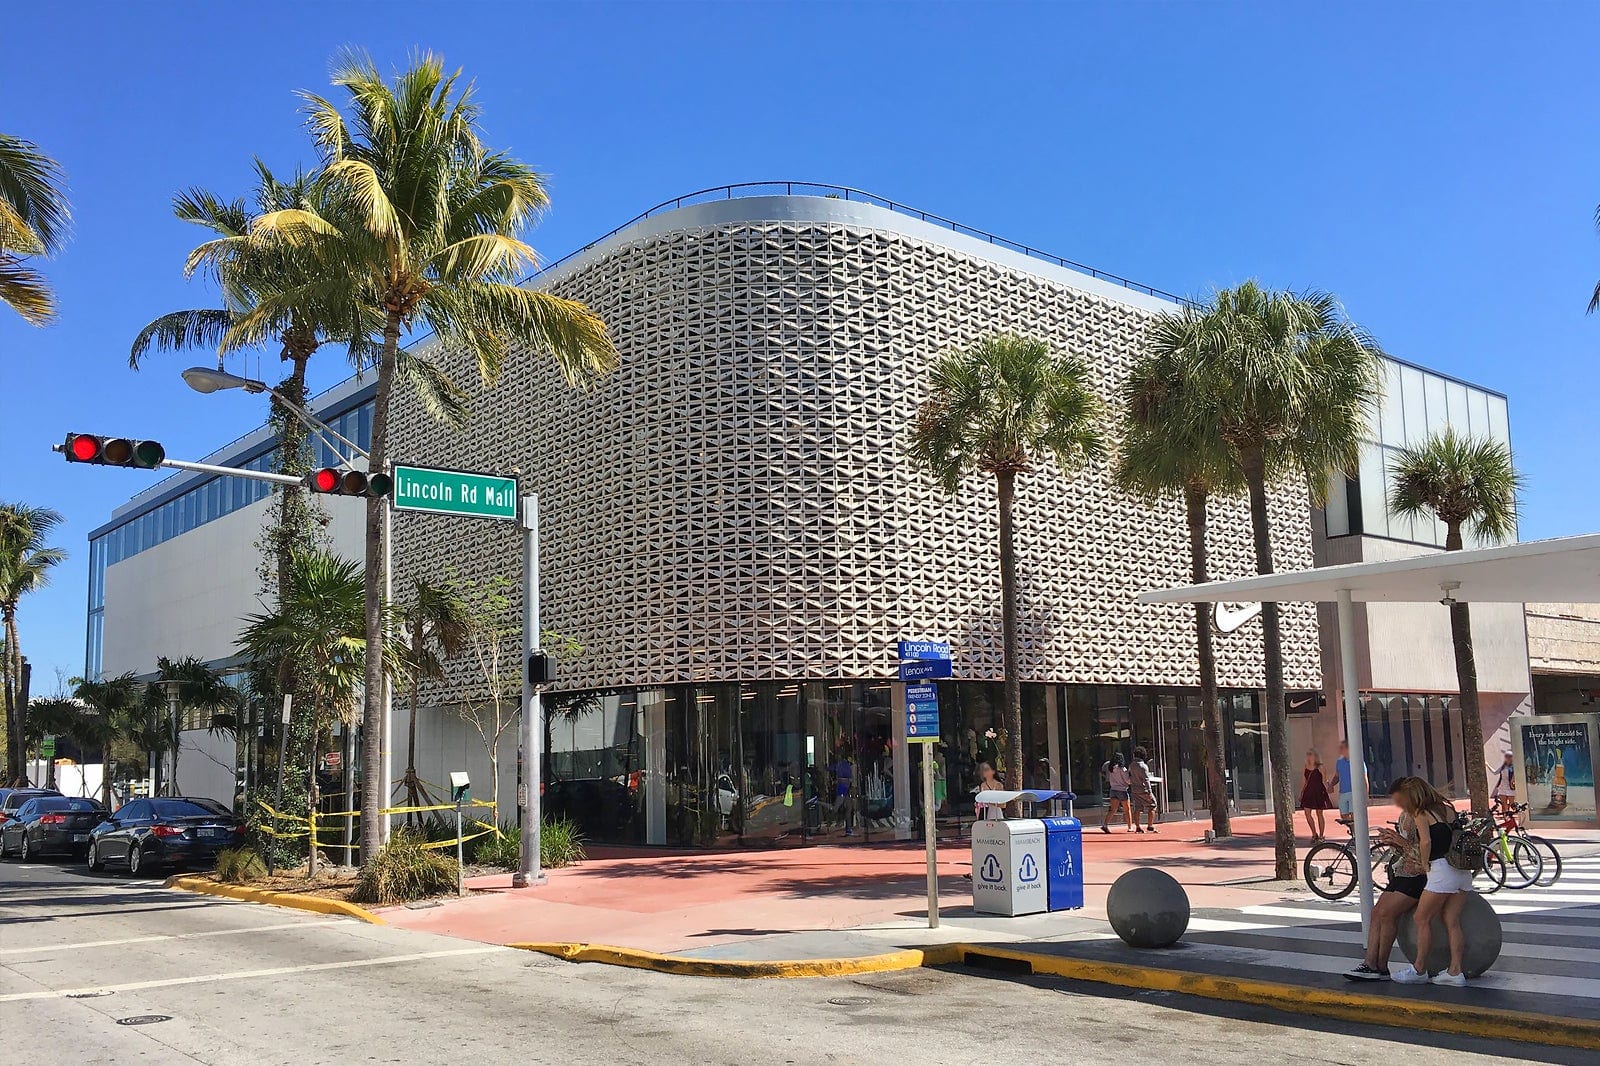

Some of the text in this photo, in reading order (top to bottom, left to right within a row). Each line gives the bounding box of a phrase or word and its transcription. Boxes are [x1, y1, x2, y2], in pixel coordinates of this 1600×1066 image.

[398, 476, 513, 508] Lincoln Rd Mall
[905, 643, 948, 653] Lincoln Road
[905, 668, 924, 676] Lenox
[1529, 731, 1545, 739] Every
[1548, 738, 1564, 746] bright
